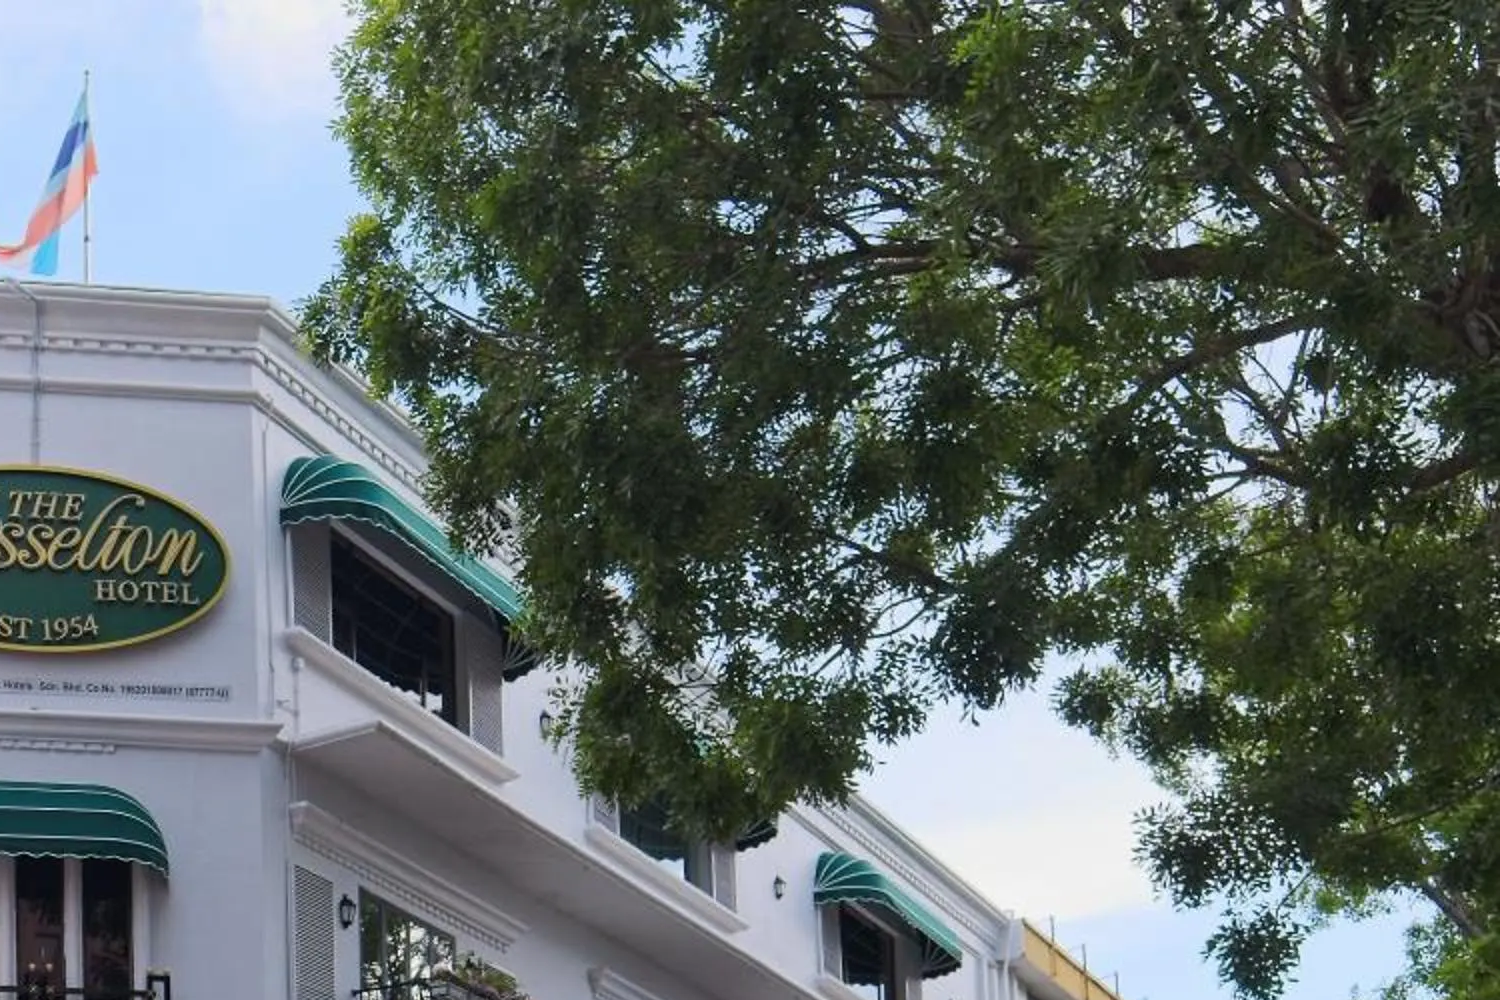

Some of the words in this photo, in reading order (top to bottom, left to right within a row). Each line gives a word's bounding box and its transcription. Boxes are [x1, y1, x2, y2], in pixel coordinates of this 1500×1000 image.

[8, 490, 86, 522] THE
[94, 578, 200, 606] HOTEL
[41, 613, 99, 641] 1954
